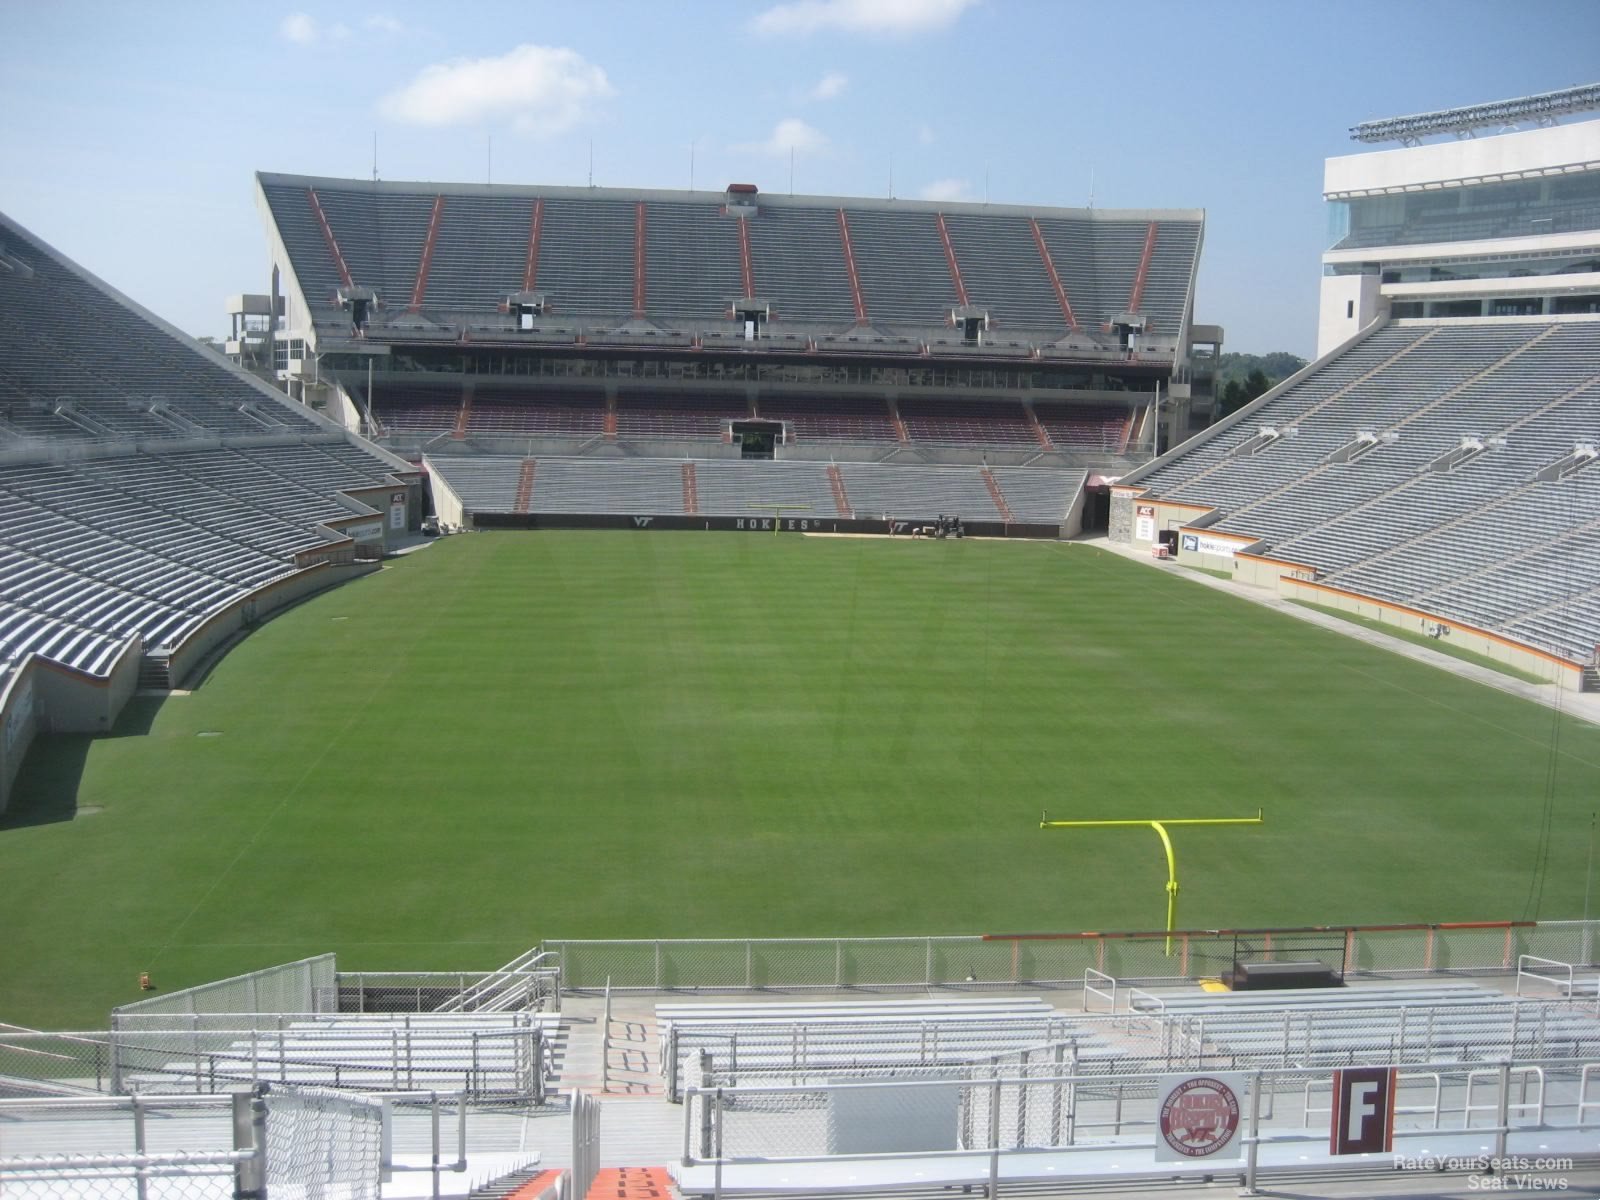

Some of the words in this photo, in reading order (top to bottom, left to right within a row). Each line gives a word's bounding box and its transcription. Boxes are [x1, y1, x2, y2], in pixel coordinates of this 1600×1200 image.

[1139, 507, 1152, 515] ACC
[633, 516, 654, 527] VT
[736, 518, 809, 530] HOKIES
[1186, 1080, 1198, 1089] THE
[1197, 1079, 1224, 1091] OPPONENT
[1348, 1081, 1379, 1141] F
[1187, 1126, 1217, 1142] VT
